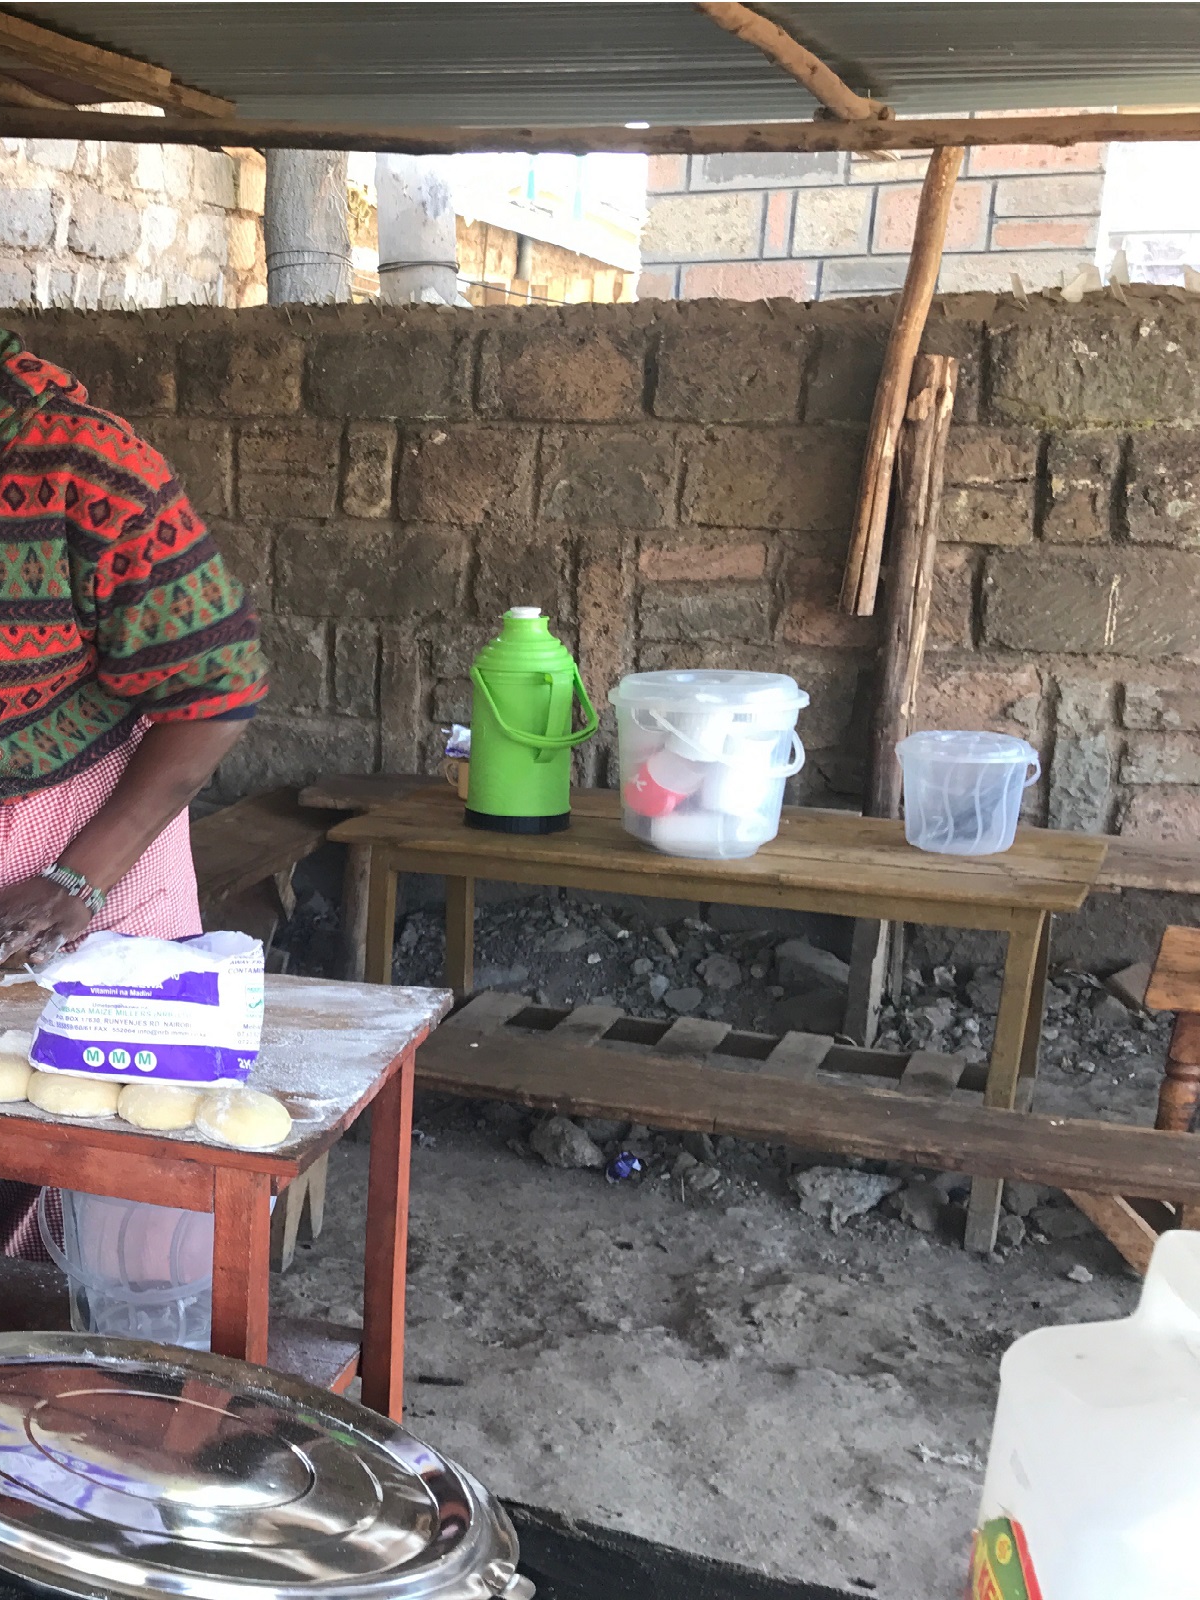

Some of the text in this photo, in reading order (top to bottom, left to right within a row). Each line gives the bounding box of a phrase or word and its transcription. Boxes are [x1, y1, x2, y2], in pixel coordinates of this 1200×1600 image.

[90, 987, 119, 995] Vitamini
[129, 989, 153, 997] Madini
[88, 1007, 113, 1016] MAIZE
[115, 1008, 152, 1018] MILLERS
[103, 1018, 148, 1027] RUNYENJES
[86, 1049, 151, 1065] M M M
